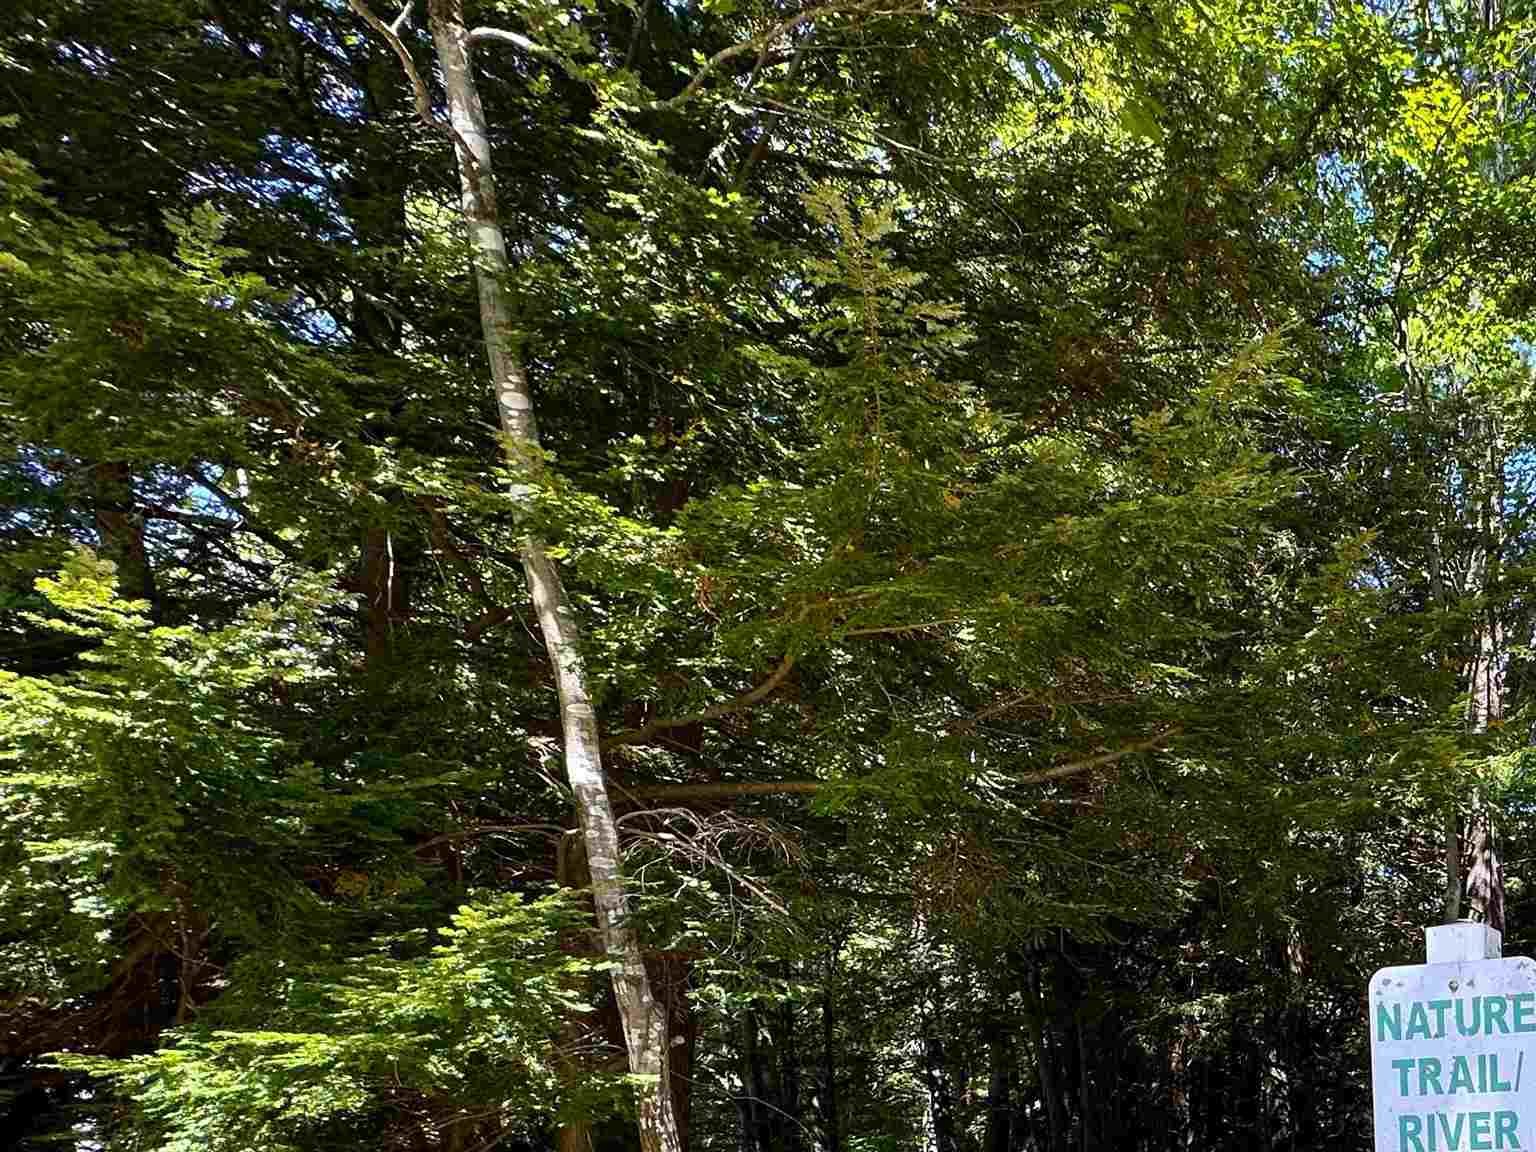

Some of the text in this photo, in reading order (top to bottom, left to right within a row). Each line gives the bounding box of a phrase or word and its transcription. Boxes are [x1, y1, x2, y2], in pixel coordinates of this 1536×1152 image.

[1376, 992, 1536, 1041] NATURE
[1391, 1051, 1524, 1096] TRAIL/
[1398, 1110, 1521, 1152] RIVER
